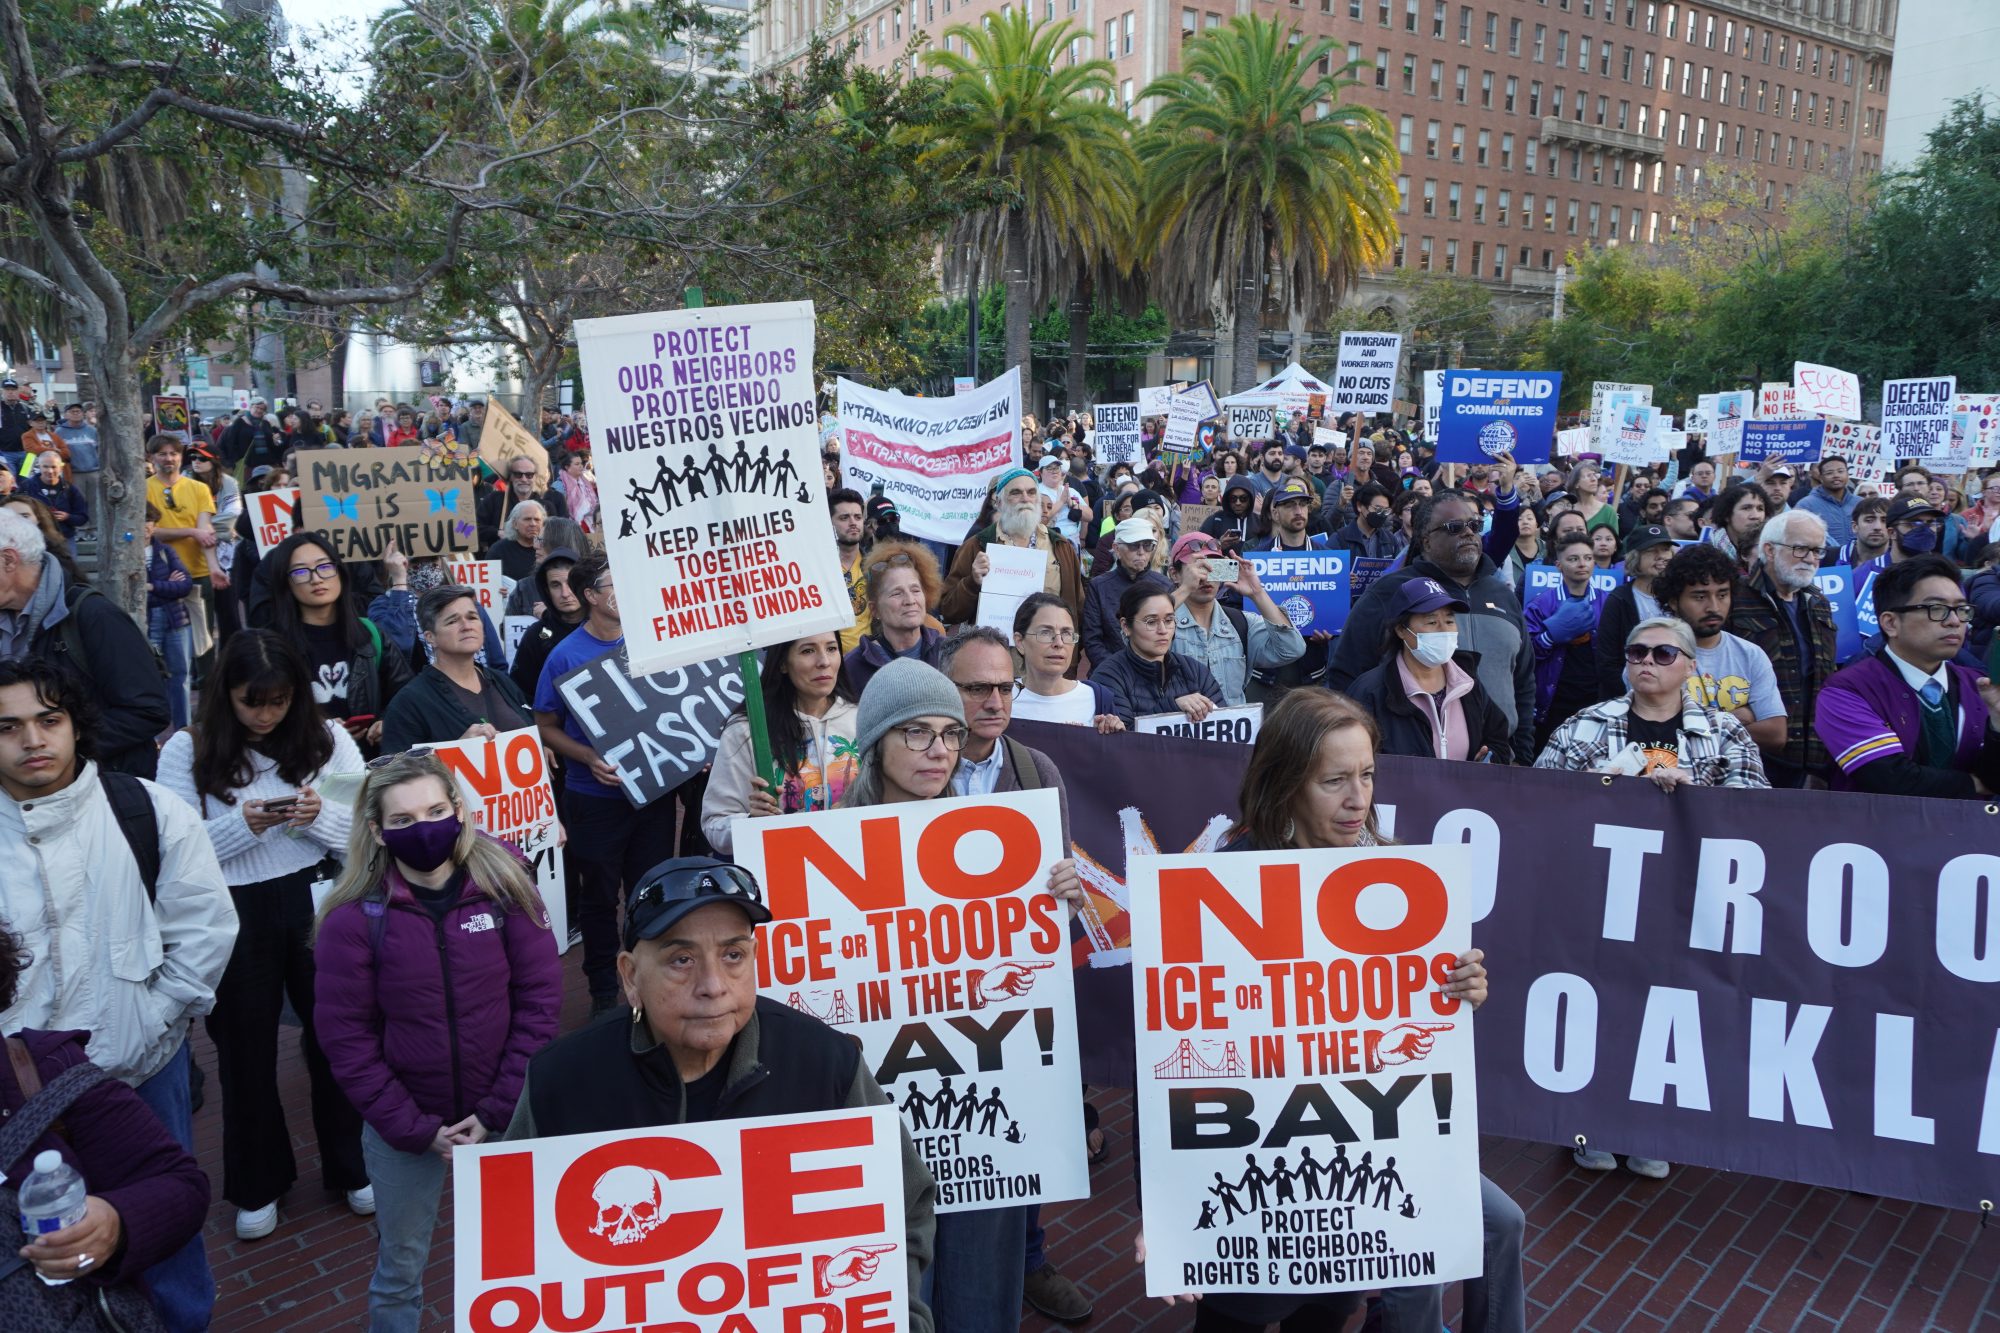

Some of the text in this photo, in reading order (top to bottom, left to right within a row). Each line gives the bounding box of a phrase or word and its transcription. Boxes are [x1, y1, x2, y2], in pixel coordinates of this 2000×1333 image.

[653, 325, 751, 359] PROTECT
[1344, 336, 1397, 347] IMMIGRANT
[1361, 349, 1377, 357] AND
[618, 347, 796, 393] OUR NEIGHBORS
[1341, 360, 1394, 369] WORKER RIGHTS
[1338, 376, 1391, 390] NO CUTS
[1451, 377, 1553, 399] DEFEND
[1594, 383, 1616, 391] OUST
[1800, 370, 1854, 393] FUCK
[631, 378, 781, 421] PROTEGIENDO
[1336, 392, 1388, 405] NO RAIDS
[1764, 391, 1778, 402] NO
[1888, 382, 1951, 403] DEFEND
[1456, 404, 1544, 416] COMMUNITIES
[1764, 404, 1778, 415] NO
[1811, 391, 1856, 416] ICE!
[1885, 403, 1949, 416] DEMOCRACY:
[1097, 406, 1138, 423] DEFEND
[1232, 409, 1273, 422] HANDS
[605, 400, 815, 454] NUESTROS VECINOS
[1097, 422, 1139, 433] DEMOCRACY:
[1234, 424, 1269, 438] OFF!
[1621, 431, 1645, 441] UESF
[1718, 421, 1740, 430] UESF
[1824, 423, 1860, 438] ODOS
[1884, 419, 1949, 433] IT'S TIME FOR
[1097, 433, 1139, 445] IT'S TIME FOR
[1102, 442, 1135, 453] A GENERAL
[1745, 440, 1811, 448] NO TROOPS
[1746, 433, 1785, 441] NO ICE
[1889, 431, 1940, 445] A GENERAL
[1106, 452, 1131, 462] STRIKE!
[1764, 448, 1804, 456] TRUMP
[1896, 444, 1933, 457] STRIKE!
[312, 460, 471, 493] MIGRATION
[375, 492, 400, 520] IS
[260, 523, 288, 547] ICE
[645, 508, 795, 558] KEEP FAMILIES
[674, 539, 780, 580] TOGETHER
[1250, 557, 1343, 576] DEFEND
[994, 567, 1036, 579] peaceably
[1532, 571, 1617, 592] DEND
[660, 561, 802, 612] MANTENIENDO
[1260, 581, 1337, 592] COMMUNITIES
[652, 584, 823, 642] FAMILIAS UNIDAS
[603, 672, 763, 804] FASCIS
[434, 734, 543, 797] NO
[484, 783, 555, 833] TROOPS
[762, 805, 1042, 921] NO
[469, 914, 485, 922] THE
[1158, 858, 1449, 964] NO
[460, 919, 486, 931] NORTH
[469, 925, 487, 934] FACE
[755, 893, 1060, 989] ICE OR TROOPS
[857, 969, 964, 1023] IN THE
[1145, 952, 1461, 1031] ICE OR TROOPS
[873, 1006, 1054, 1086] AY!
[1250, 1029, 1361, 1079] IN THE
[1523, 972, 2000, 1155] OAKL
[1168, 1072, 1453, 1150] BAY!
[912, 1132, 962, 1159] TECT
[926, 1154, 1001, 1183] HBORS,
[479, 1116, 886, 1281] ICE
[932, 1172, 1042, 1207] NSTITUTION
[1261, 1206, 1355, 1234] PROTECT
[1216, 1229, 1395, 1260] OUR NEIGHBORS,
[1183, 1251, 1436, 1286] RIGHTS & CONSTITUTION
[468, 1269, 665, 1333] OUT
[677, 1252, 803, 1316] OF
